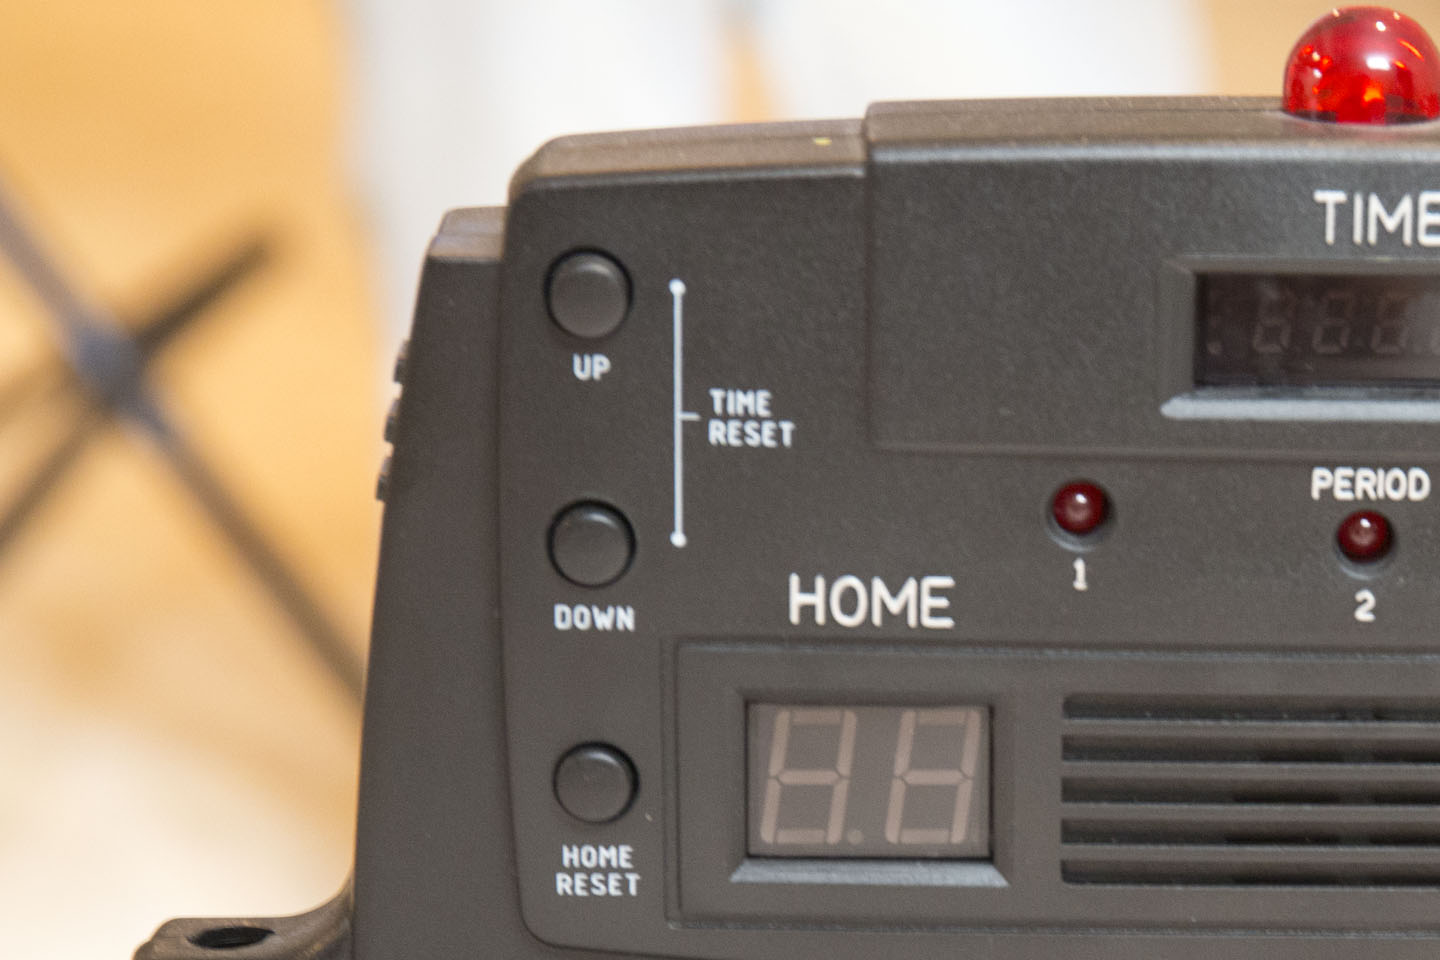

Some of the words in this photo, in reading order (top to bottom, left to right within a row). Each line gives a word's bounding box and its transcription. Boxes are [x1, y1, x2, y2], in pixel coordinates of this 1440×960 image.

[573, 354, 611, 381] UP
[710, 389, 771, 416] TIME
[708, 419, 794, 447] RESET
[1311, 467, 1430, 501] PERIOD
[1073, 558, 1088, 591] 1
[789, 573, 955, 629] HOME
[1354, 589, 1376, 622] 2
[554, 604, 635, 631] DOWN
[562, 845, 633, 868] HOME
[556, 872, 641, 896] RESET
